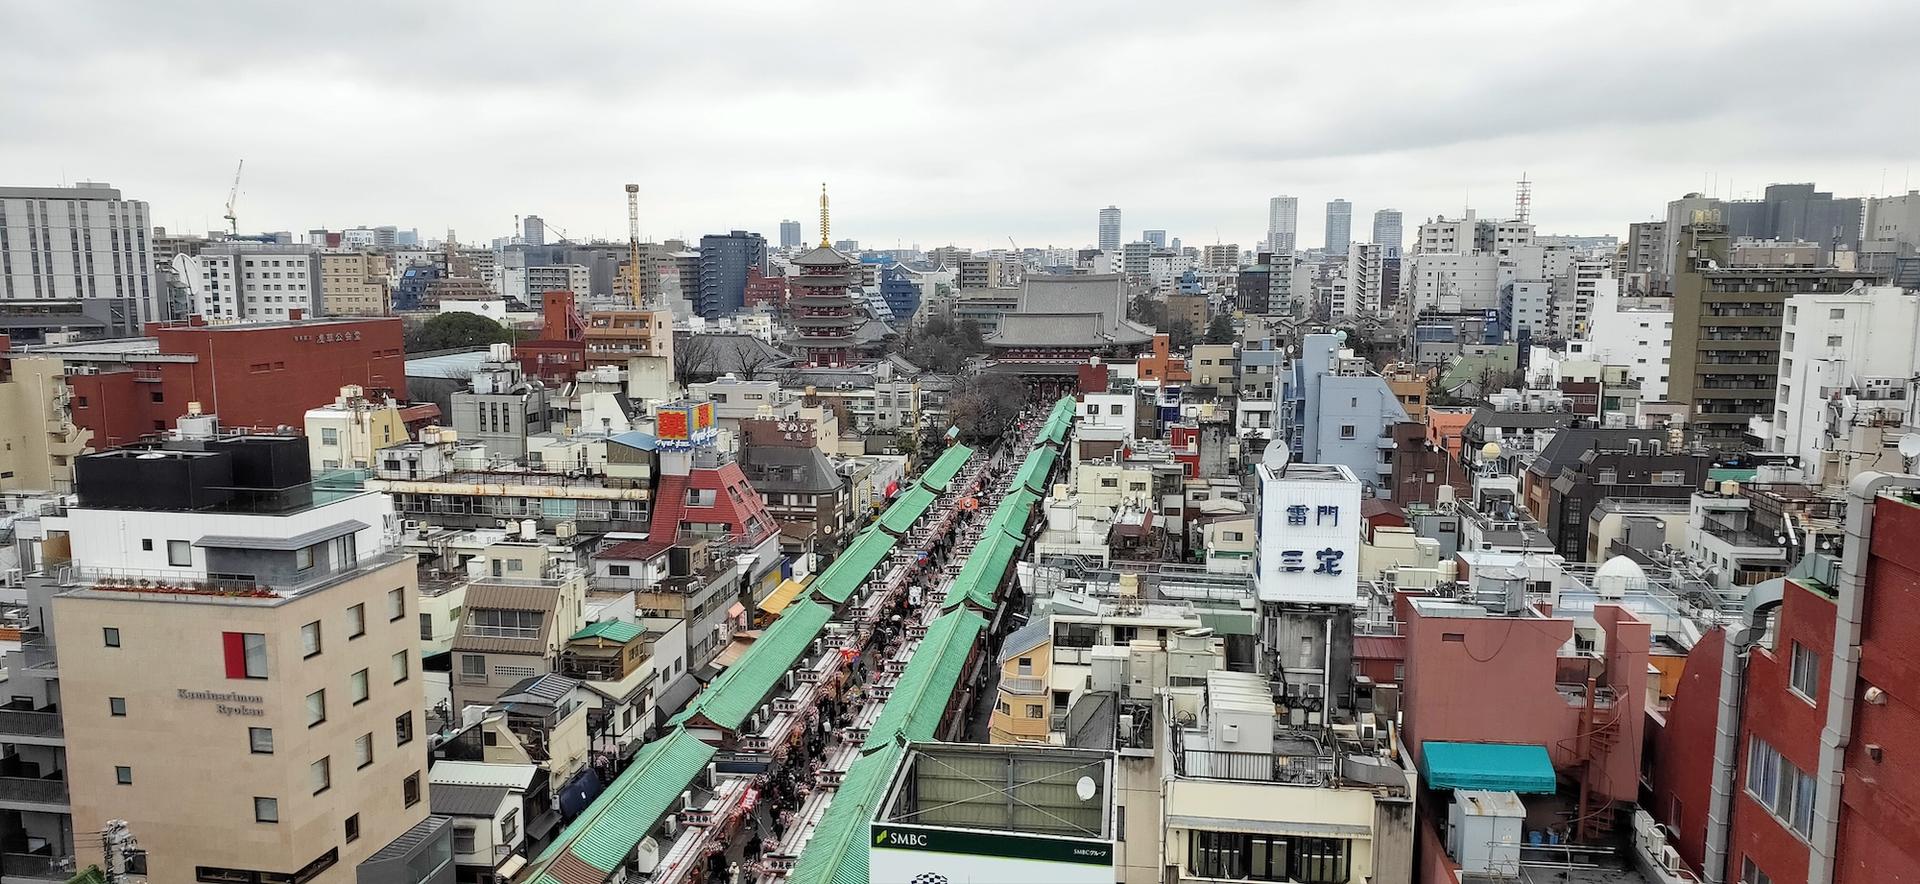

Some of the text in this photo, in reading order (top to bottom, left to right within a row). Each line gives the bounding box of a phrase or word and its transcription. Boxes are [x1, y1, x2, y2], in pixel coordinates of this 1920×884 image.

[658, 411, 687, 438] 薬
[1286, 504, 1339, 527] 雷門
[1279, 547, 1344, 577] 三定
[177, 688, 263, 703] Kaminarimon
[217, 704, 263, 716] Ryokan
[890, 832, 928, 846] SMBC
[1073, 848, 1107, 857] SMBCグループ
